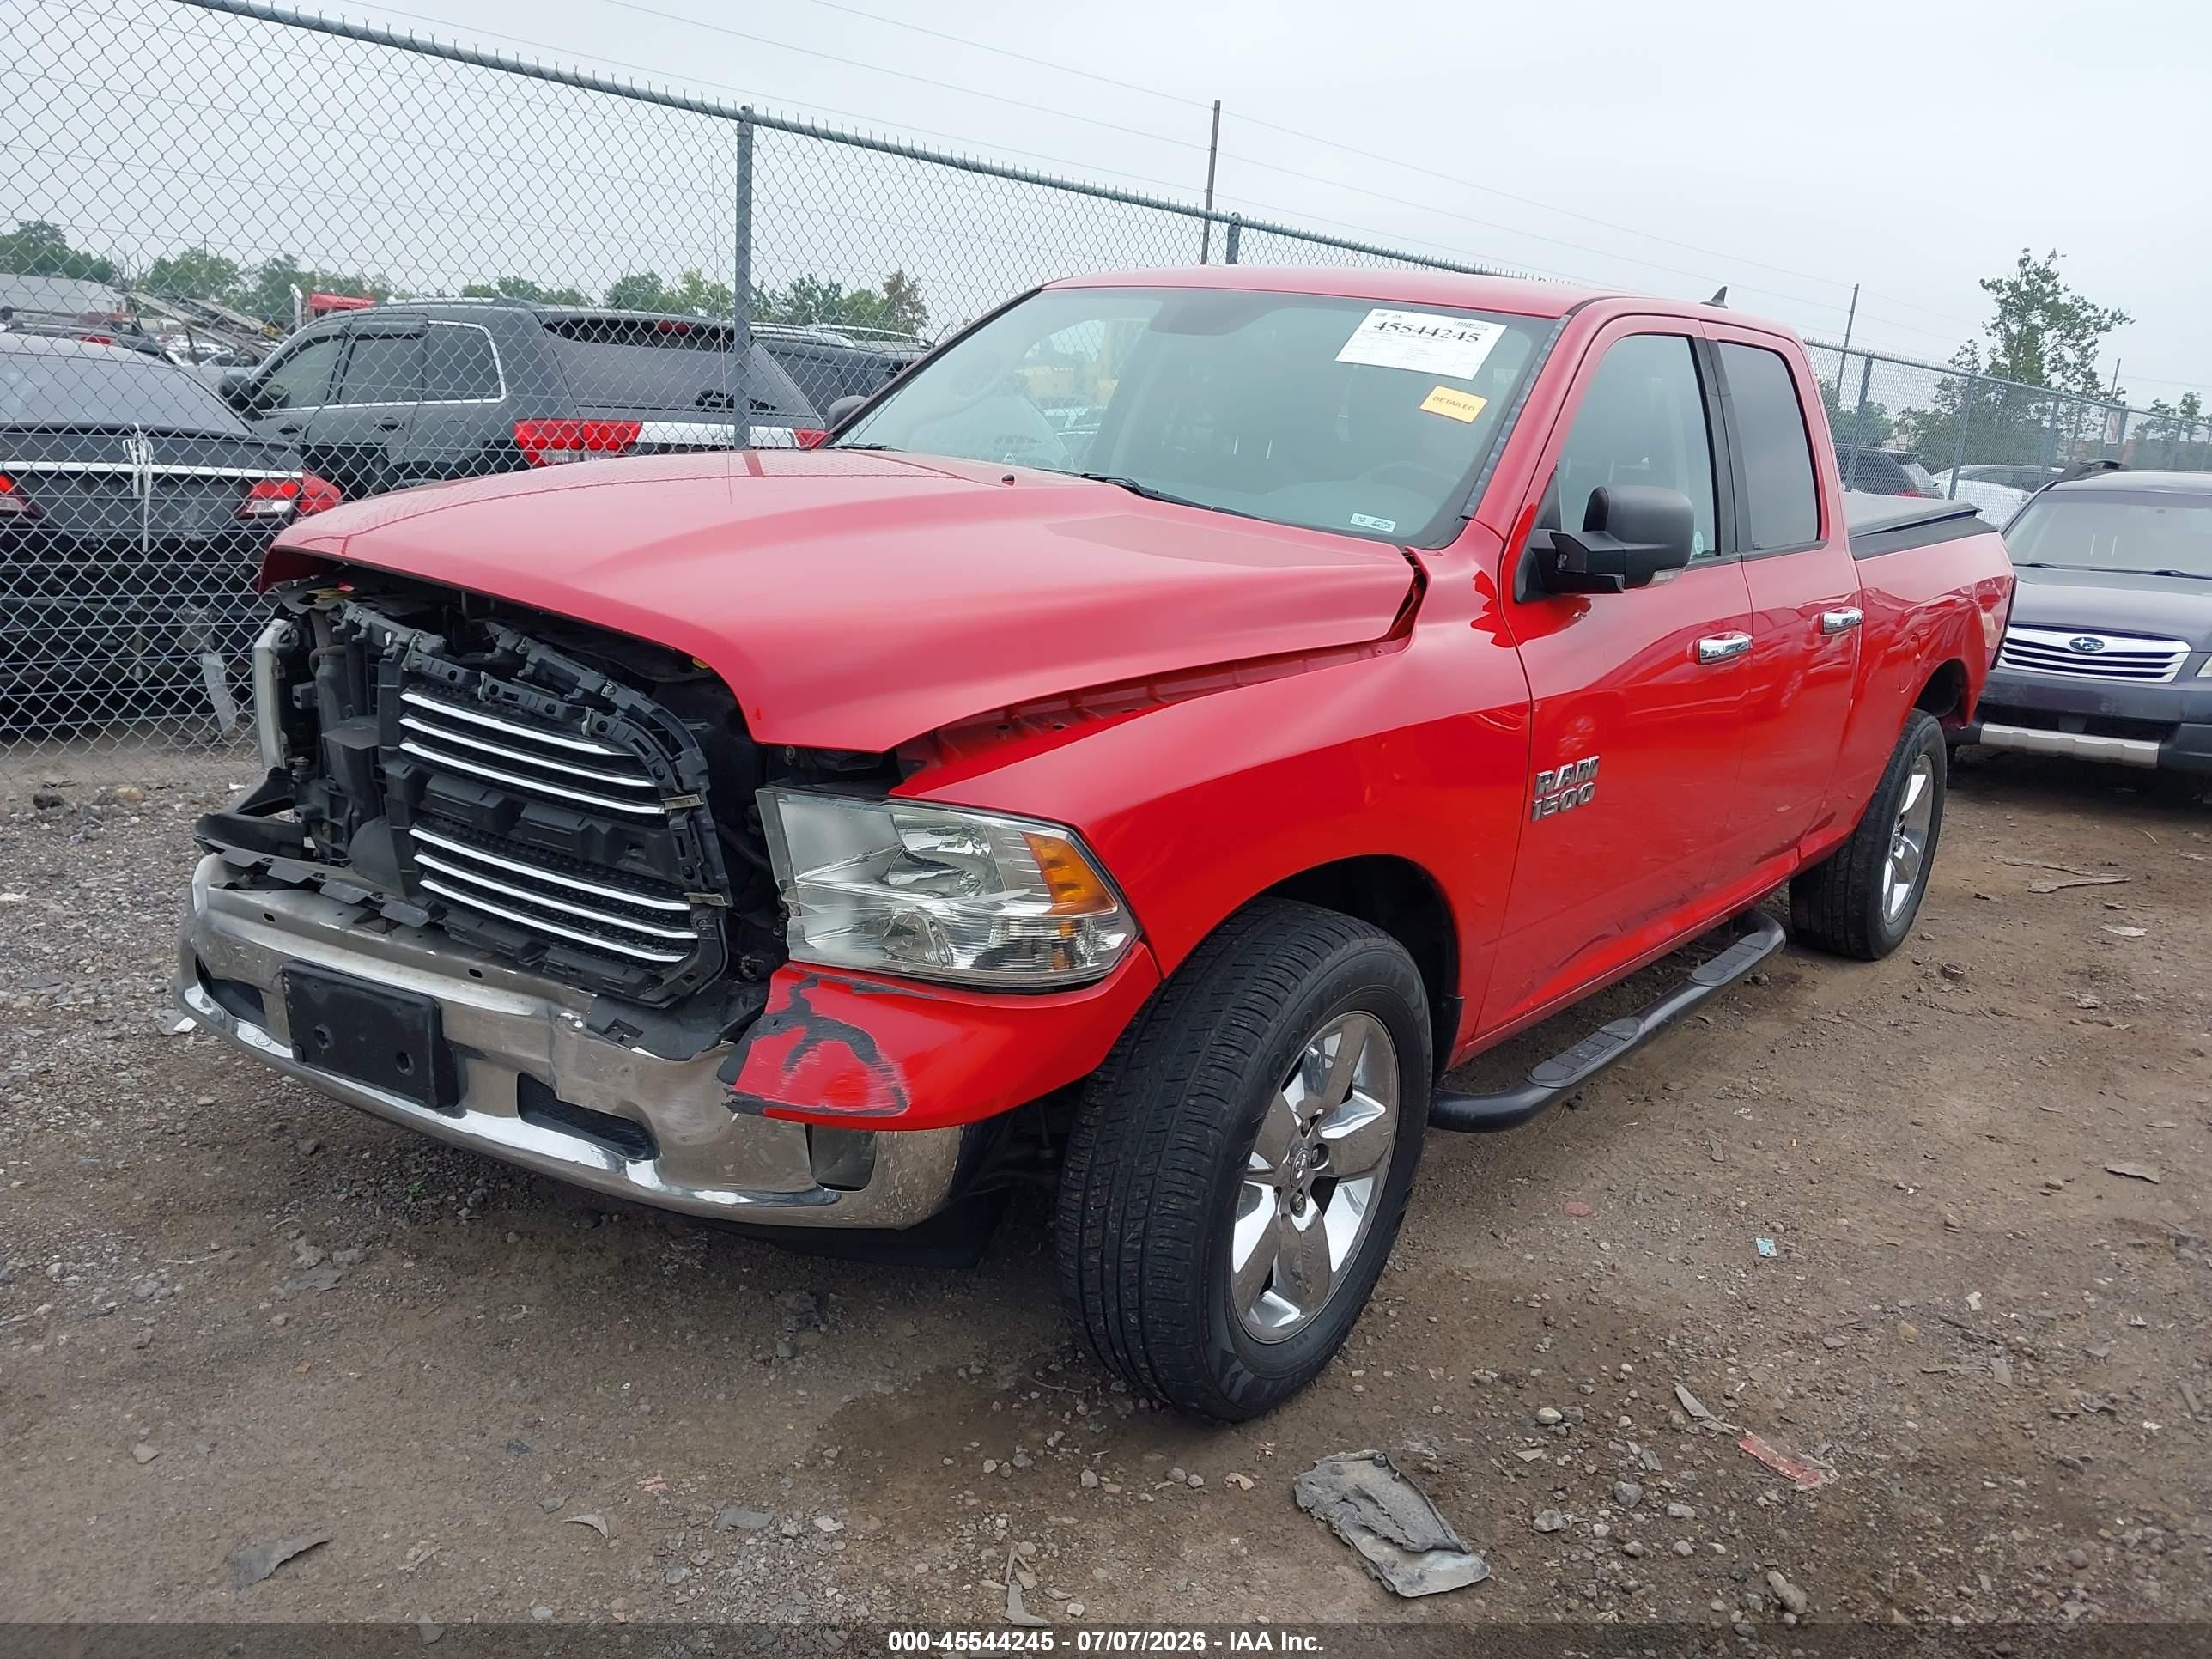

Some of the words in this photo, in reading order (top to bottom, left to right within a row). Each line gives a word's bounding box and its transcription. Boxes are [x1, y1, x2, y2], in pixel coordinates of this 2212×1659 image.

[1373, 321, 1481, 343] 45544245
[1432, 395, 1475, 411] DETAILED
[1534, 755, 1600, 798] RAM
[1532, 781, 1595, 822] 1500
